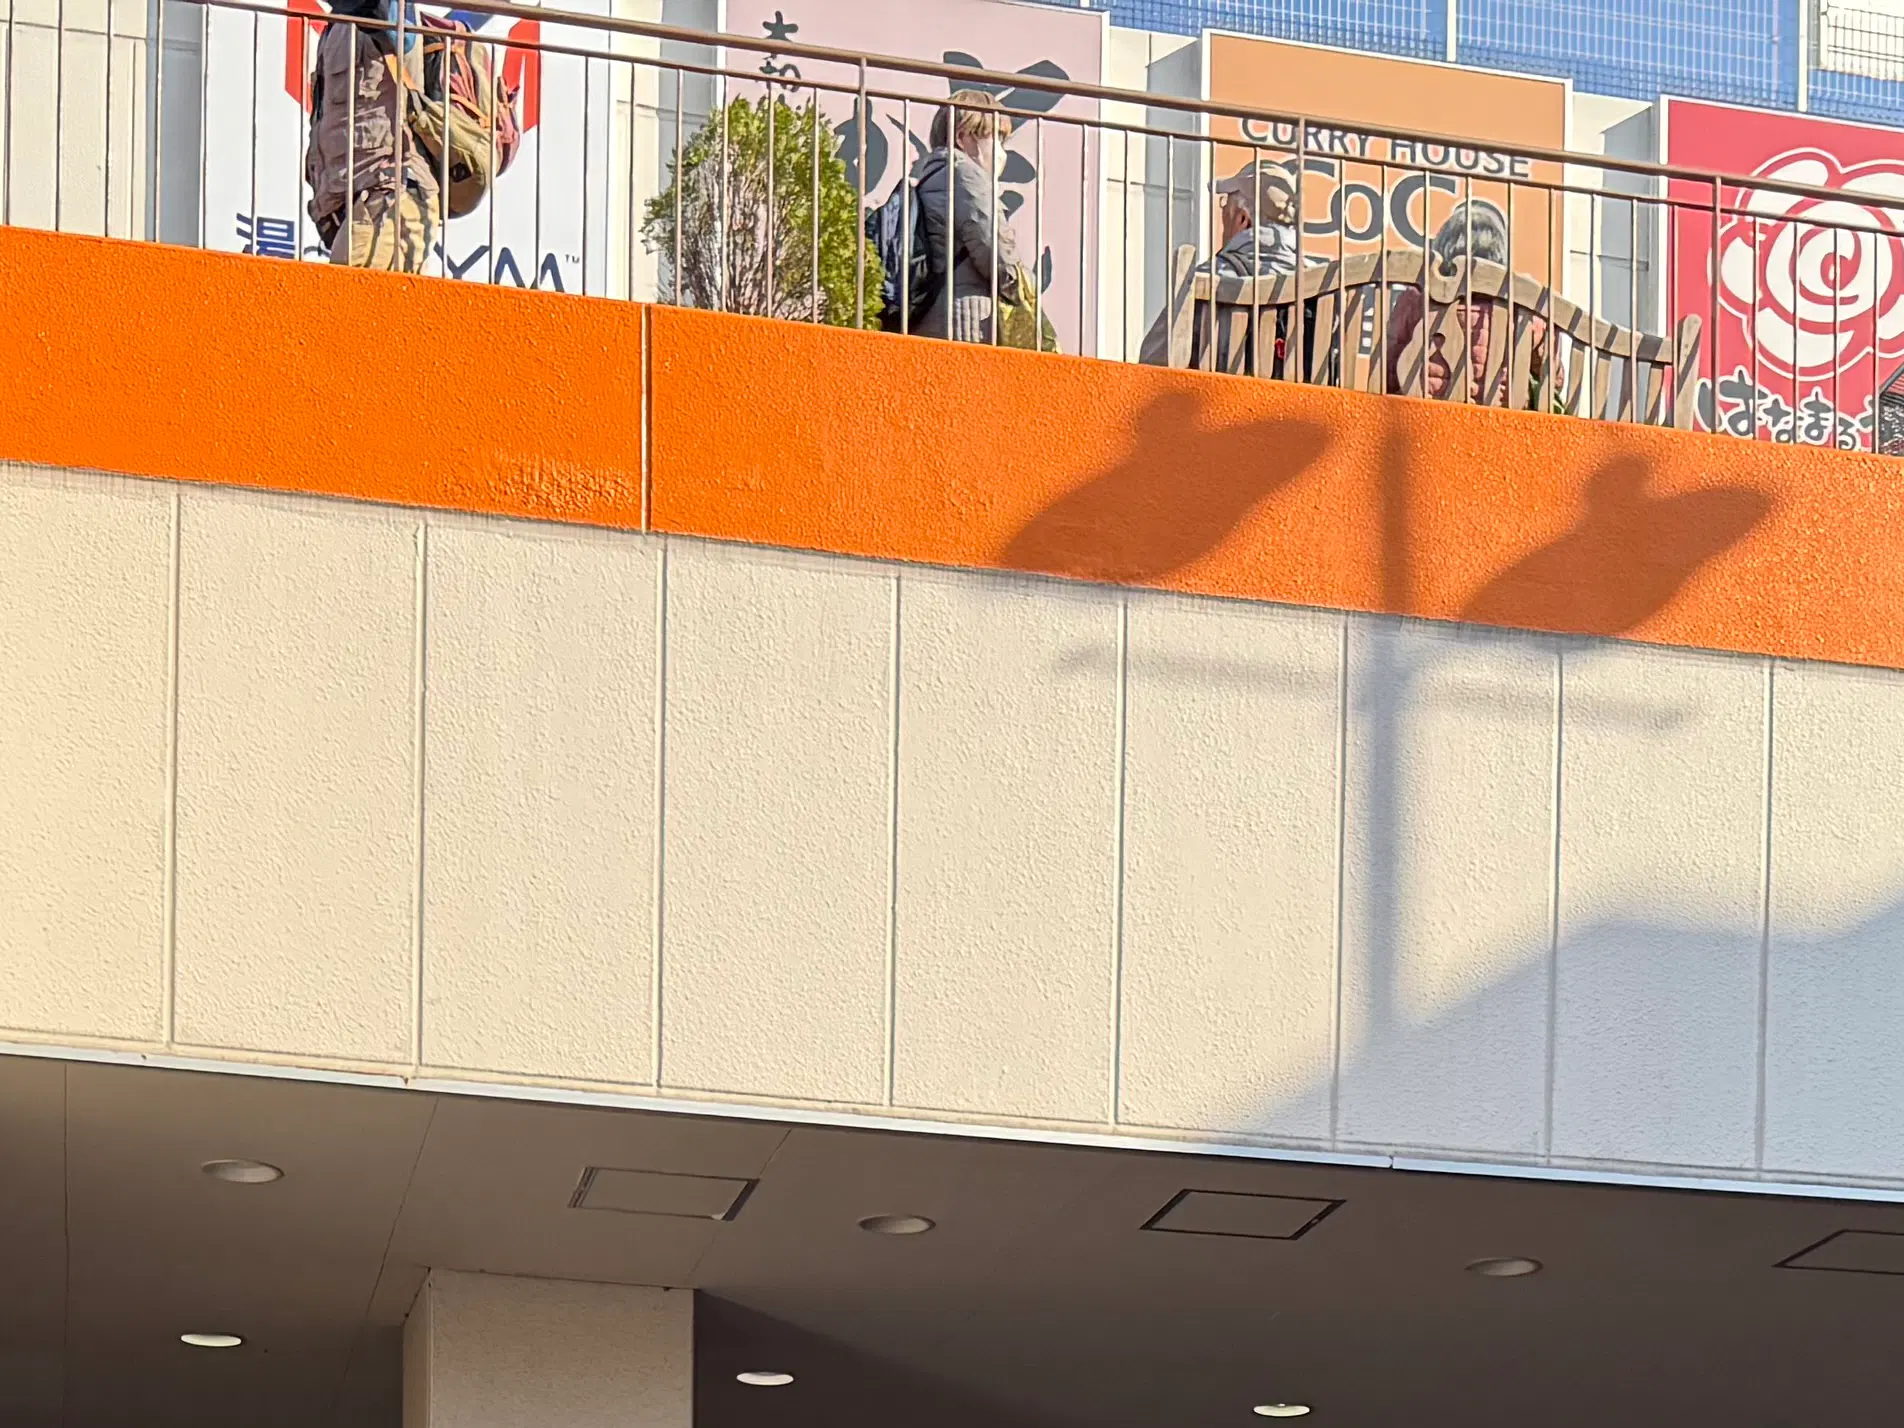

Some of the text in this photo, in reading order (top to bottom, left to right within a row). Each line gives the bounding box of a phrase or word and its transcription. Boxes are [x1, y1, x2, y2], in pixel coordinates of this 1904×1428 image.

[1240, 117, 1530, 179] CURRY HOUSE
[1697, 370, 1874, 449] はなまる
